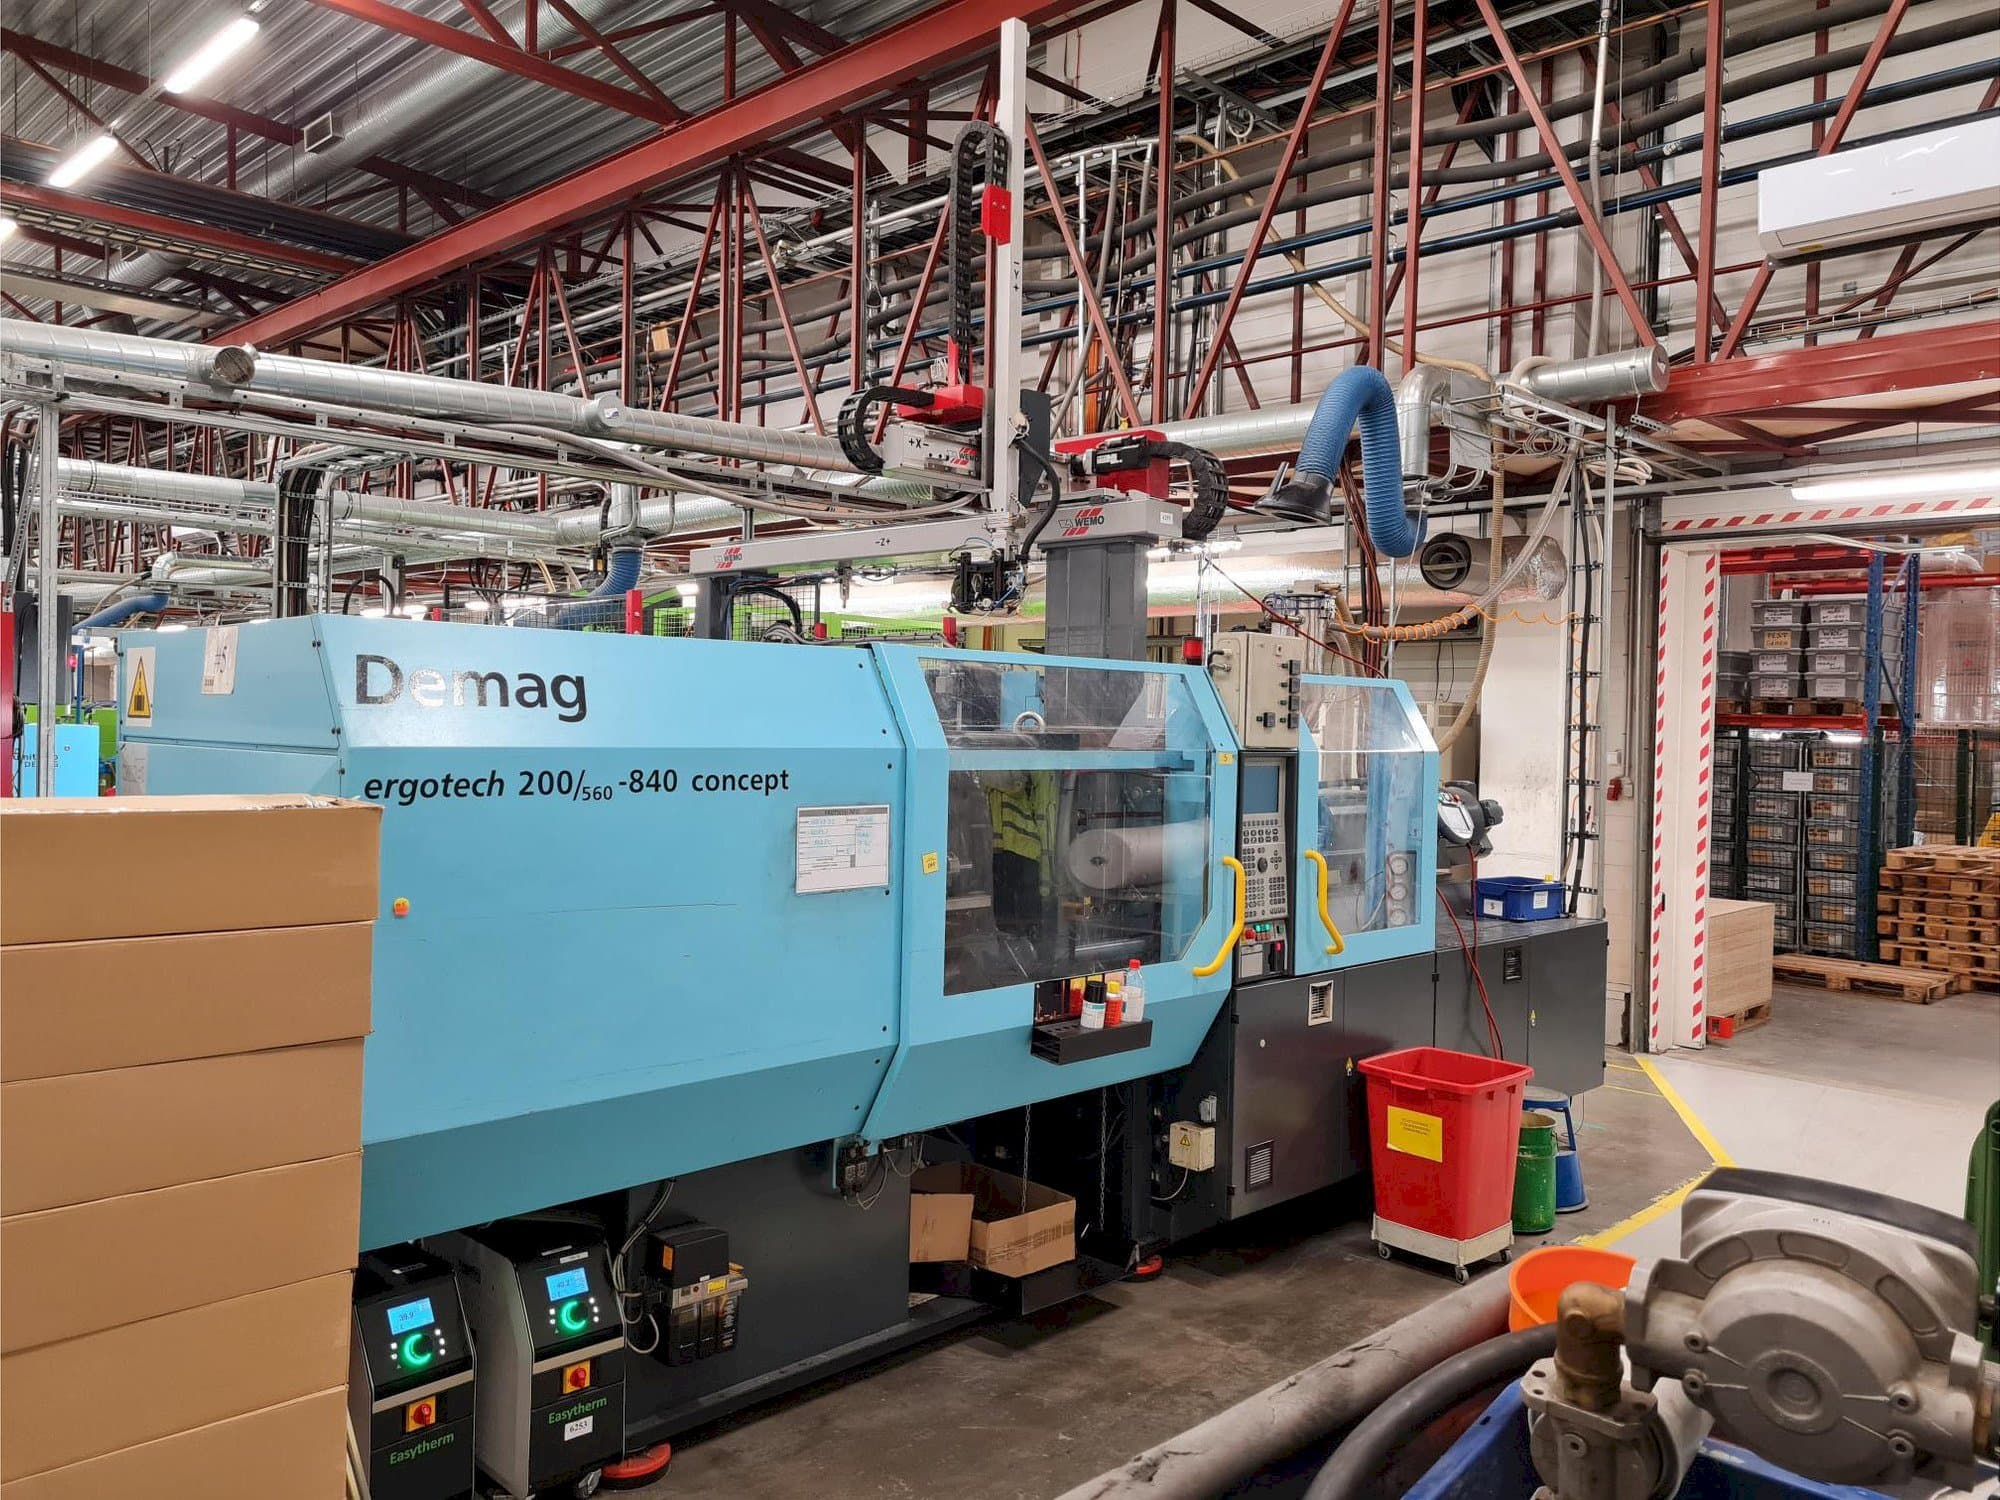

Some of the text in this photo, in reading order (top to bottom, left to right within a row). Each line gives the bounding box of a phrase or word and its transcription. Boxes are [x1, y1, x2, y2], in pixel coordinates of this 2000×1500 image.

[1075, 515, 1105, 527] WEMO
[355, 654, 587, 723] Demag
[363, 769, 506, 807] ergotech
[691, 769, 790, 797] concept
[548, 1398, 607, 1425] Easytherm
[569, 1420, 588, 1433] 6253
[390, 1432, 454, 1465] Easytherm
